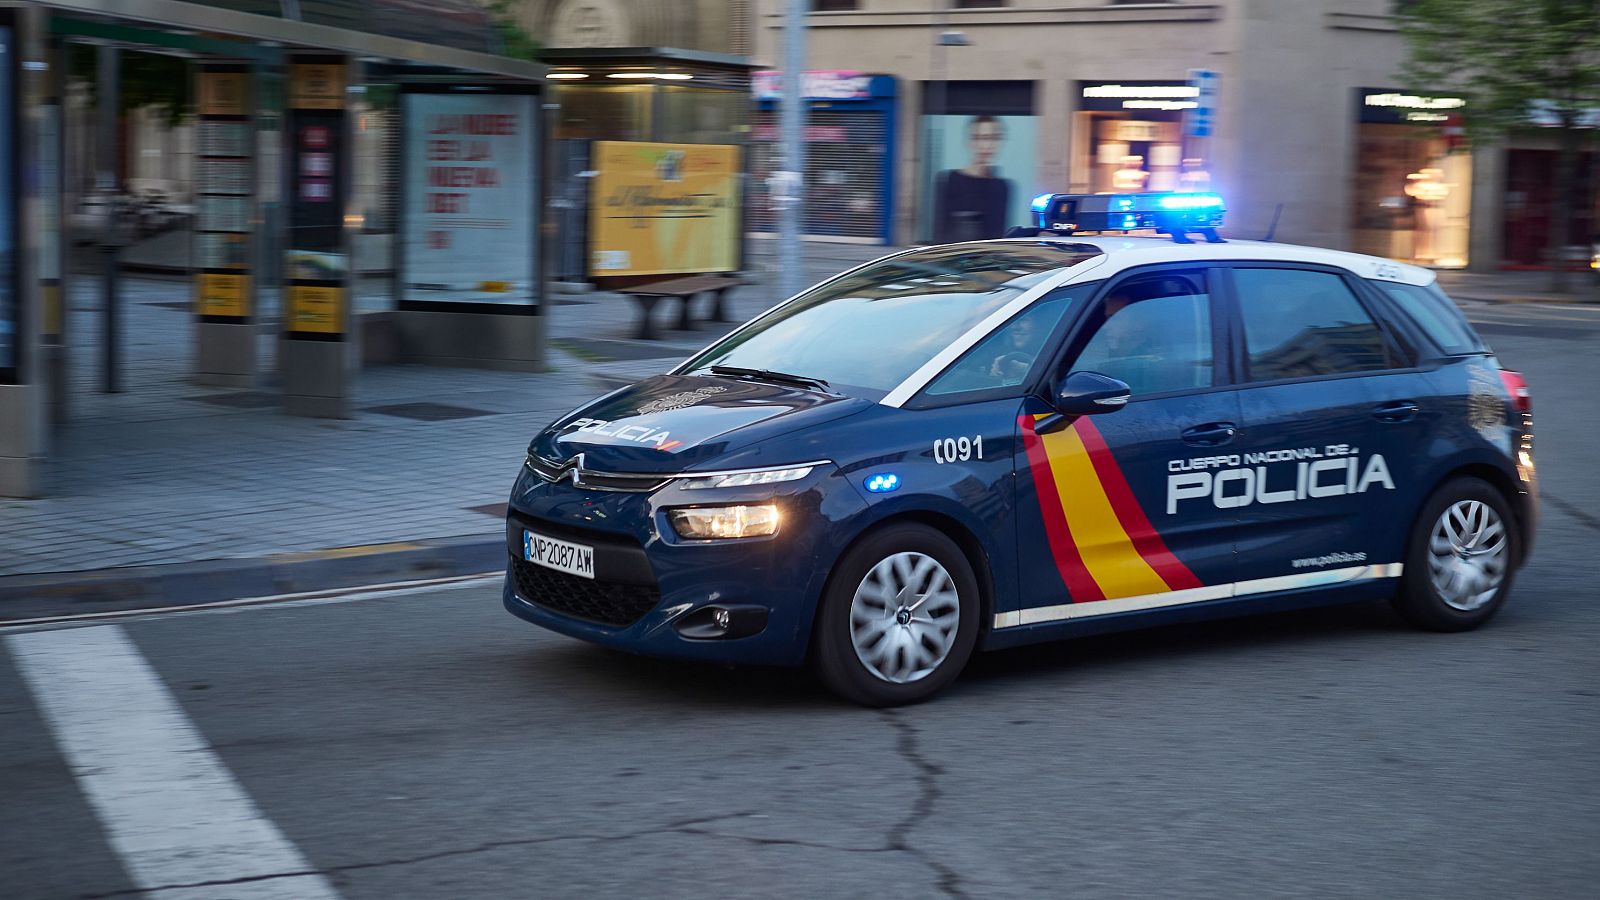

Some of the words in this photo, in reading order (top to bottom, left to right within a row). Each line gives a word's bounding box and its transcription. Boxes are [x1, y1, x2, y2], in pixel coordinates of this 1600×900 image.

[563, 418, 670, 446] POLICÍA
[1168, 454, 1240, 472] CUERPO
[1243, 447, 1324, 465] NACIONAL
[1325, 443, 1350, 457] DE
[1166, 448, 1395, 514] POLICÍA
